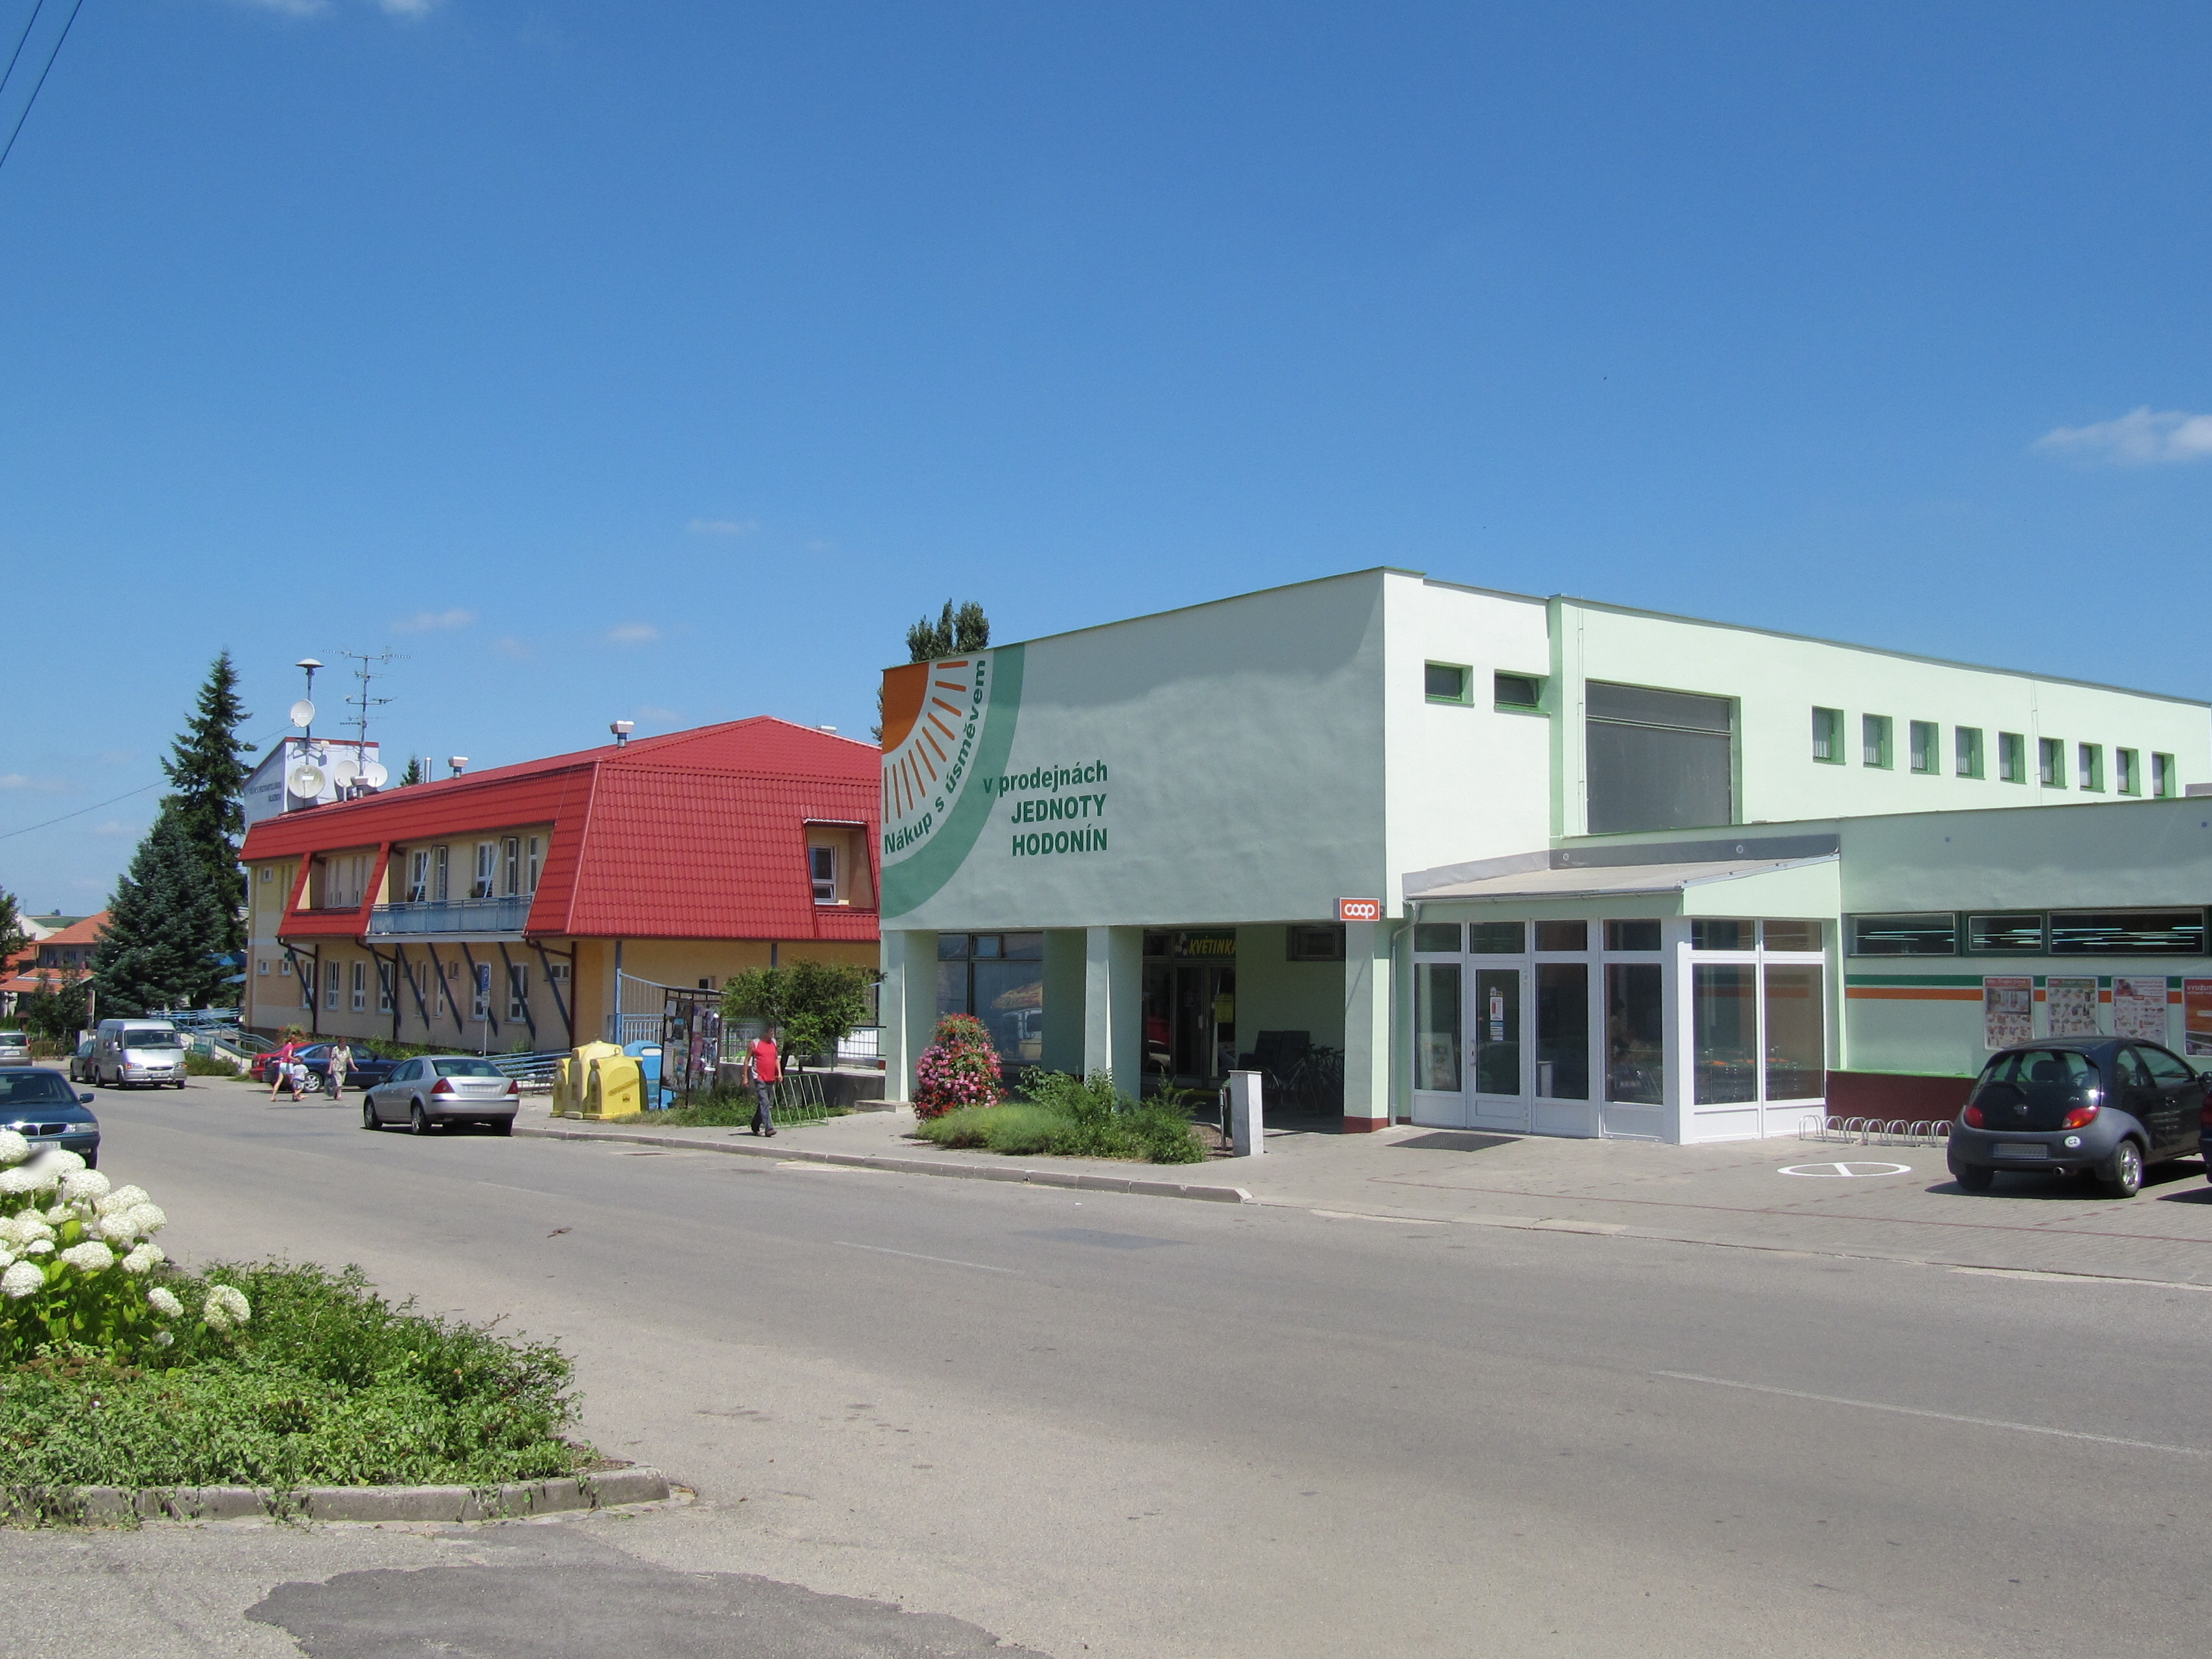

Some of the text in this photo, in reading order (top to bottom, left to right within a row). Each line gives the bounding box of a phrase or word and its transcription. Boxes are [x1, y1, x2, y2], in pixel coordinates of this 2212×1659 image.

[884, 660, 986, 854] Nákup s úsměvem
[983, 759, 1108, 798] v prodejnách
[1011, 794, 1107, 824] JEDNOTY
[1012, 824, 1108, 856] HODONÍN
[1344, 903, 1375, 919] coop
